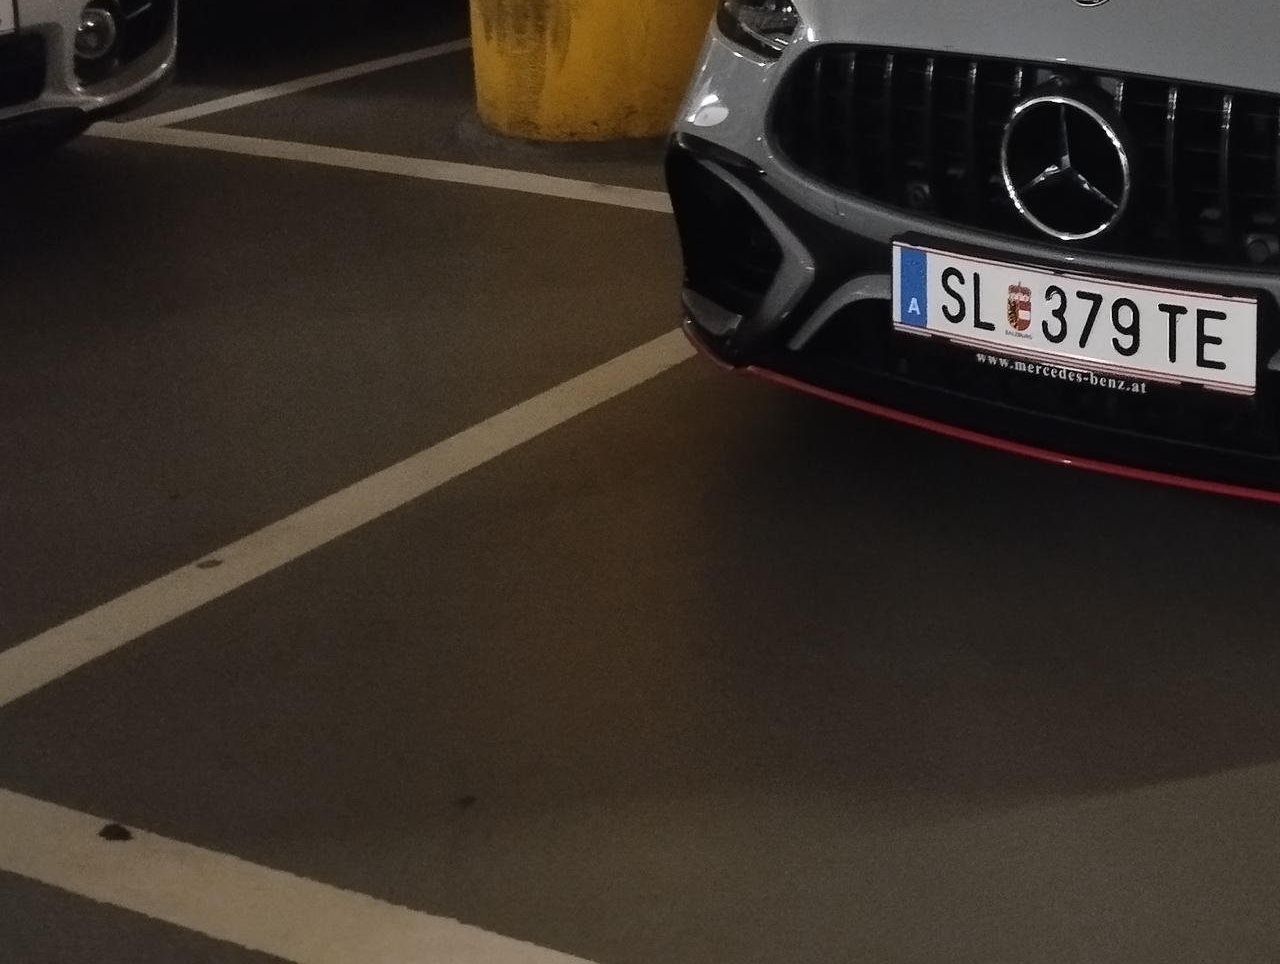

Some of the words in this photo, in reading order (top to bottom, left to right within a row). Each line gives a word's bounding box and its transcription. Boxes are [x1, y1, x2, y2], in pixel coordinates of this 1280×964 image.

[907, 297, 921, 316] A
[941, 266, 995, 331] SL
[1041, 285, 1140, 357] 379
[1158, 302, 1227, 370] TE
[976, 351, 1147, 394] www.mercedes-benz.at
